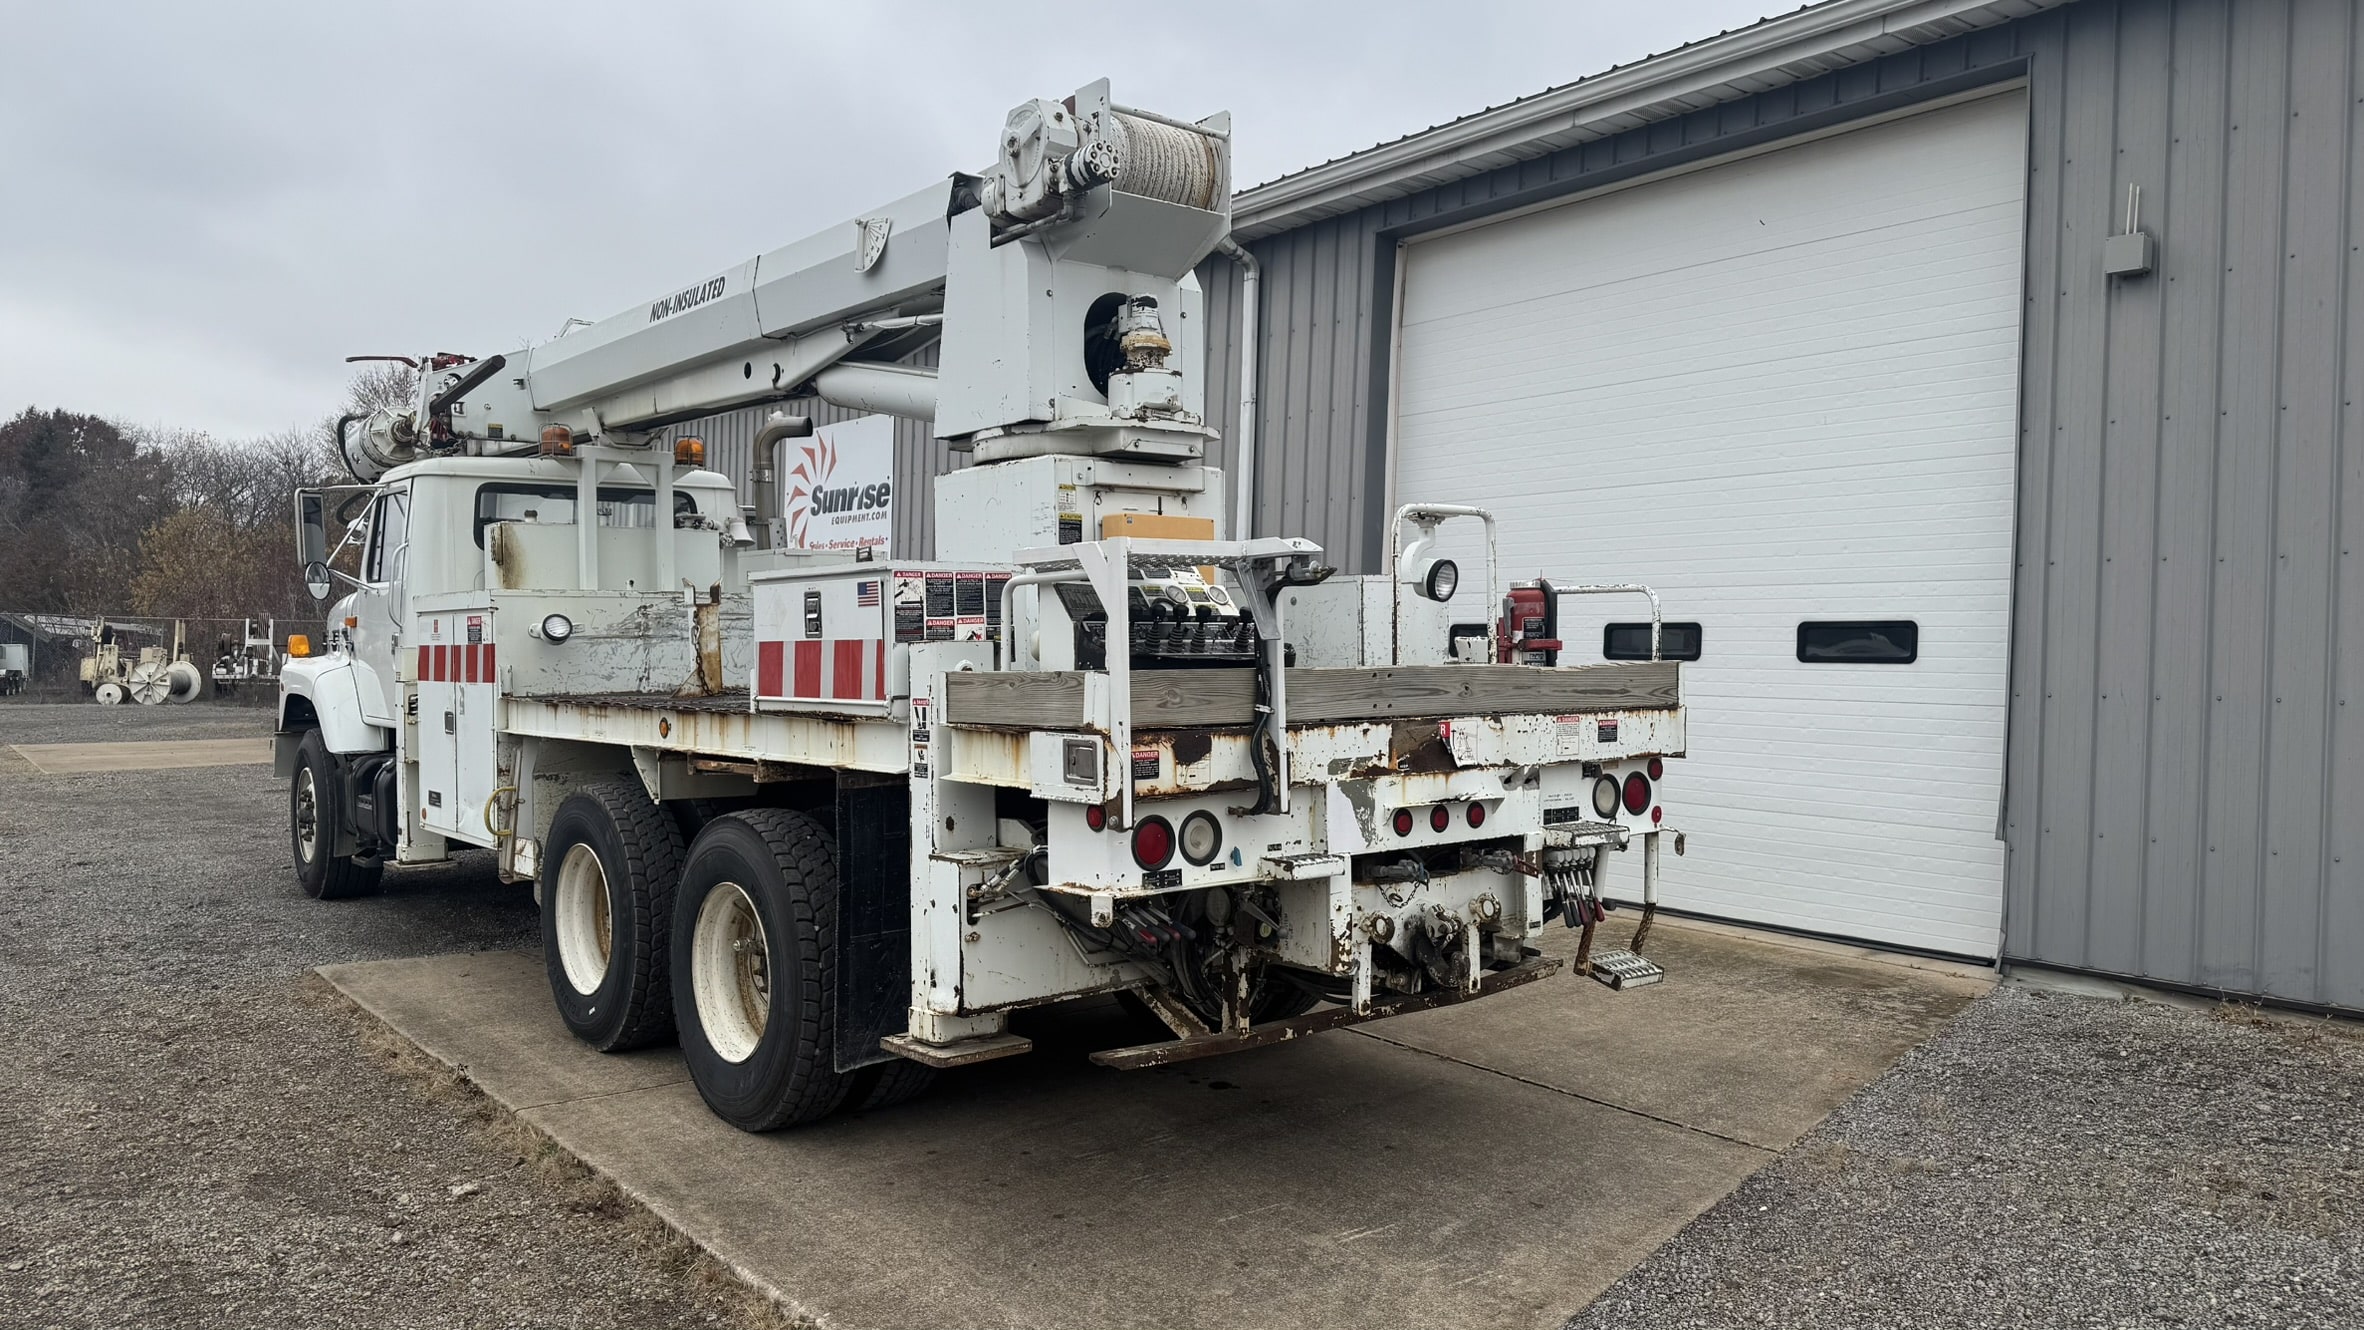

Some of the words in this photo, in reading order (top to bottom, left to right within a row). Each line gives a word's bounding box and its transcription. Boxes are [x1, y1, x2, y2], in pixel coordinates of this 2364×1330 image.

[649, 276, 726, 323] NON-INSULATED
[810, 482, 891, 516] Sunrise
[831, 511, 888, 525] EQUIPMENT.COM
[828, 539, 856, 549] Service
[858, 536, 885, 547] Rentals
